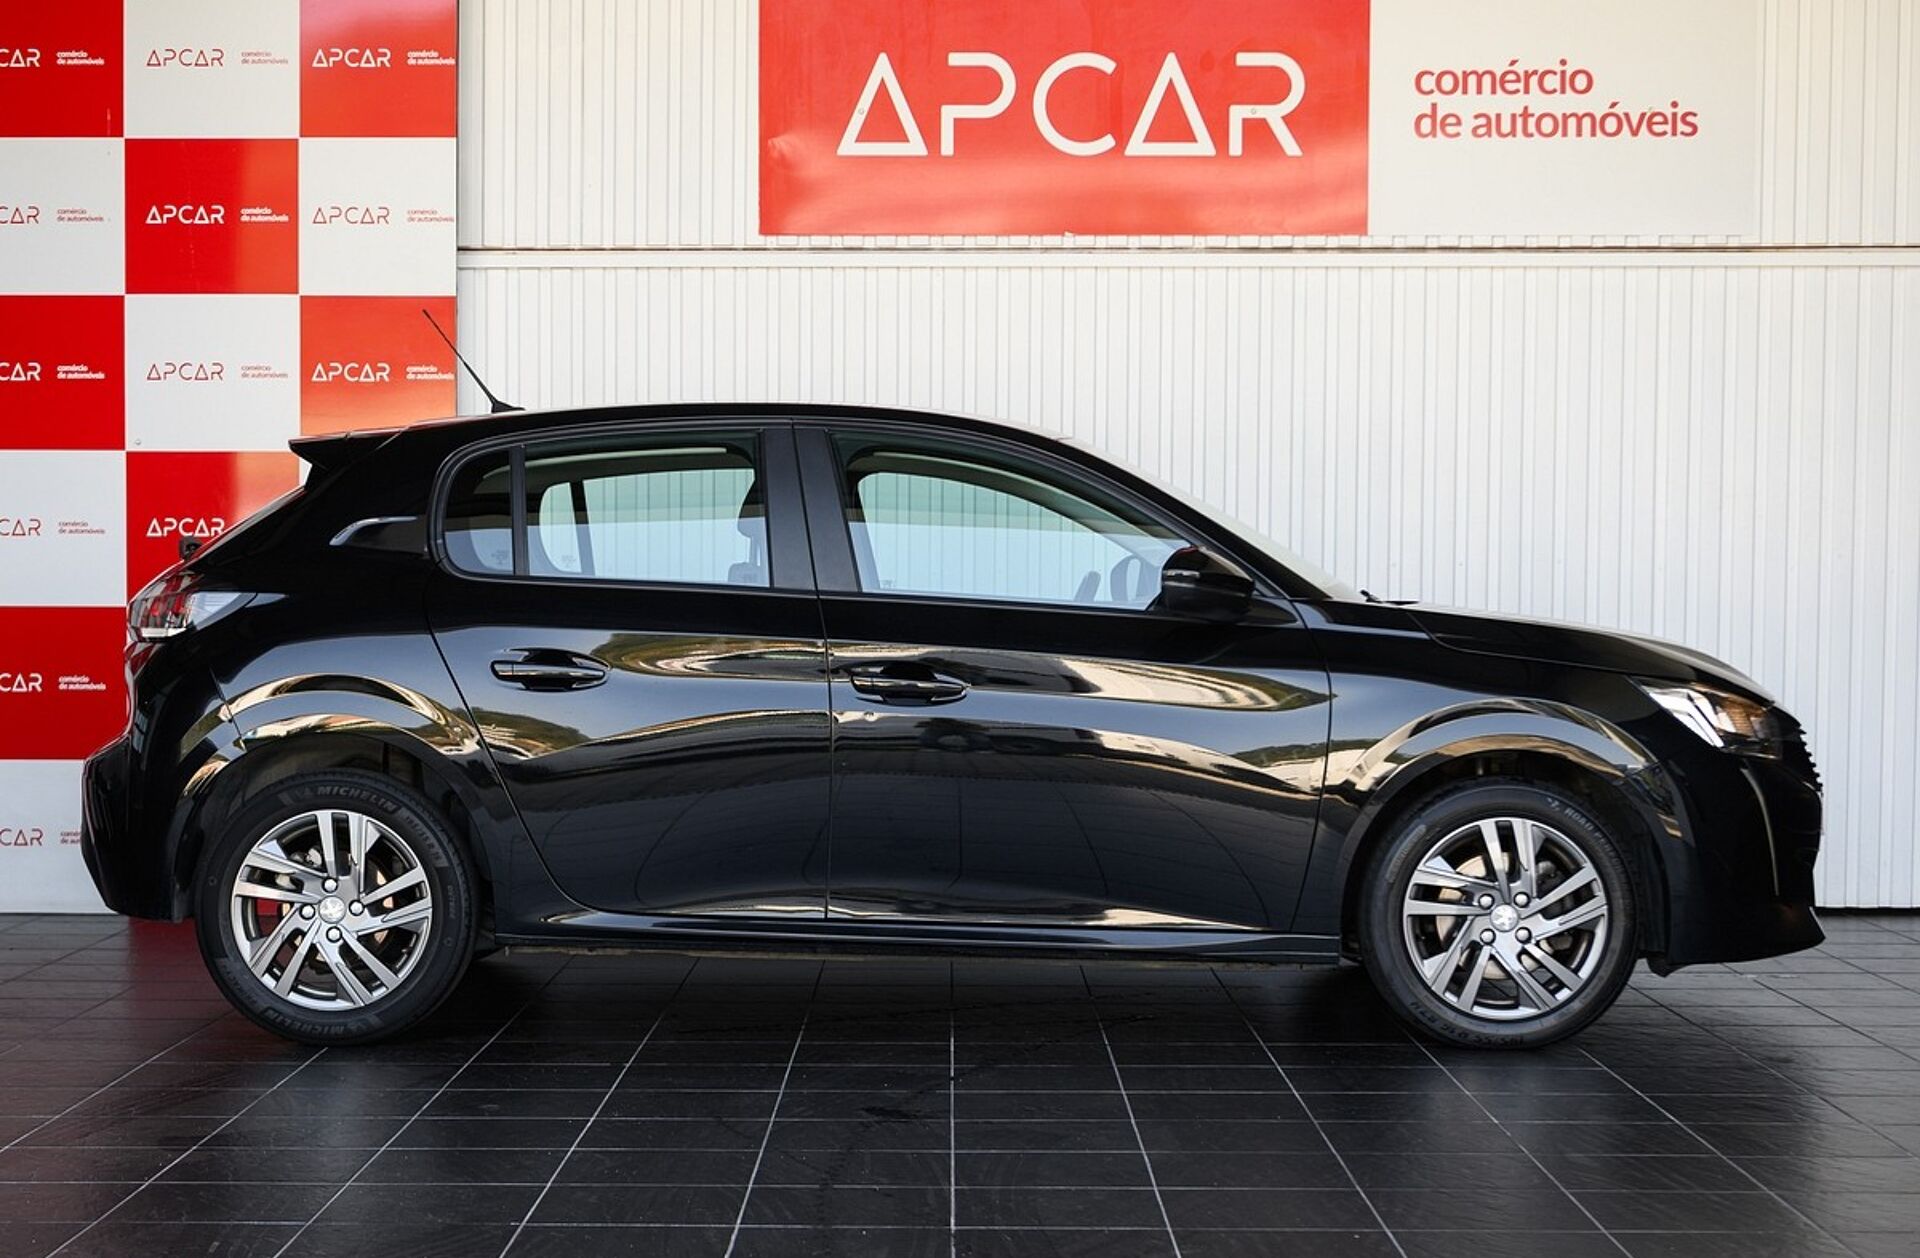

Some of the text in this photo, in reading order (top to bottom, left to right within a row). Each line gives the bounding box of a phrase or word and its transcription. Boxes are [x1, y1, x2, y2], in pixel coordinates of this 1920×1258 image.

[146, 48, 224, 67] APCAR
[312, 48, 391, 67] APCAR
[1414, 59, 1594, 95] comércio
[836, 52, 1305, 156] APCAR
[1414, 101, 1699, 138] de automóveis
[145, 205, 225, 224] APCAR
[312, 206, 390, 224] APCAR
[146, 362, 224, 381] APCAR
[311, 362, 391, 382] APCAR
[146, 518, 224, 537] APCAR
[316, 785, 397, 812] MICHELIN
